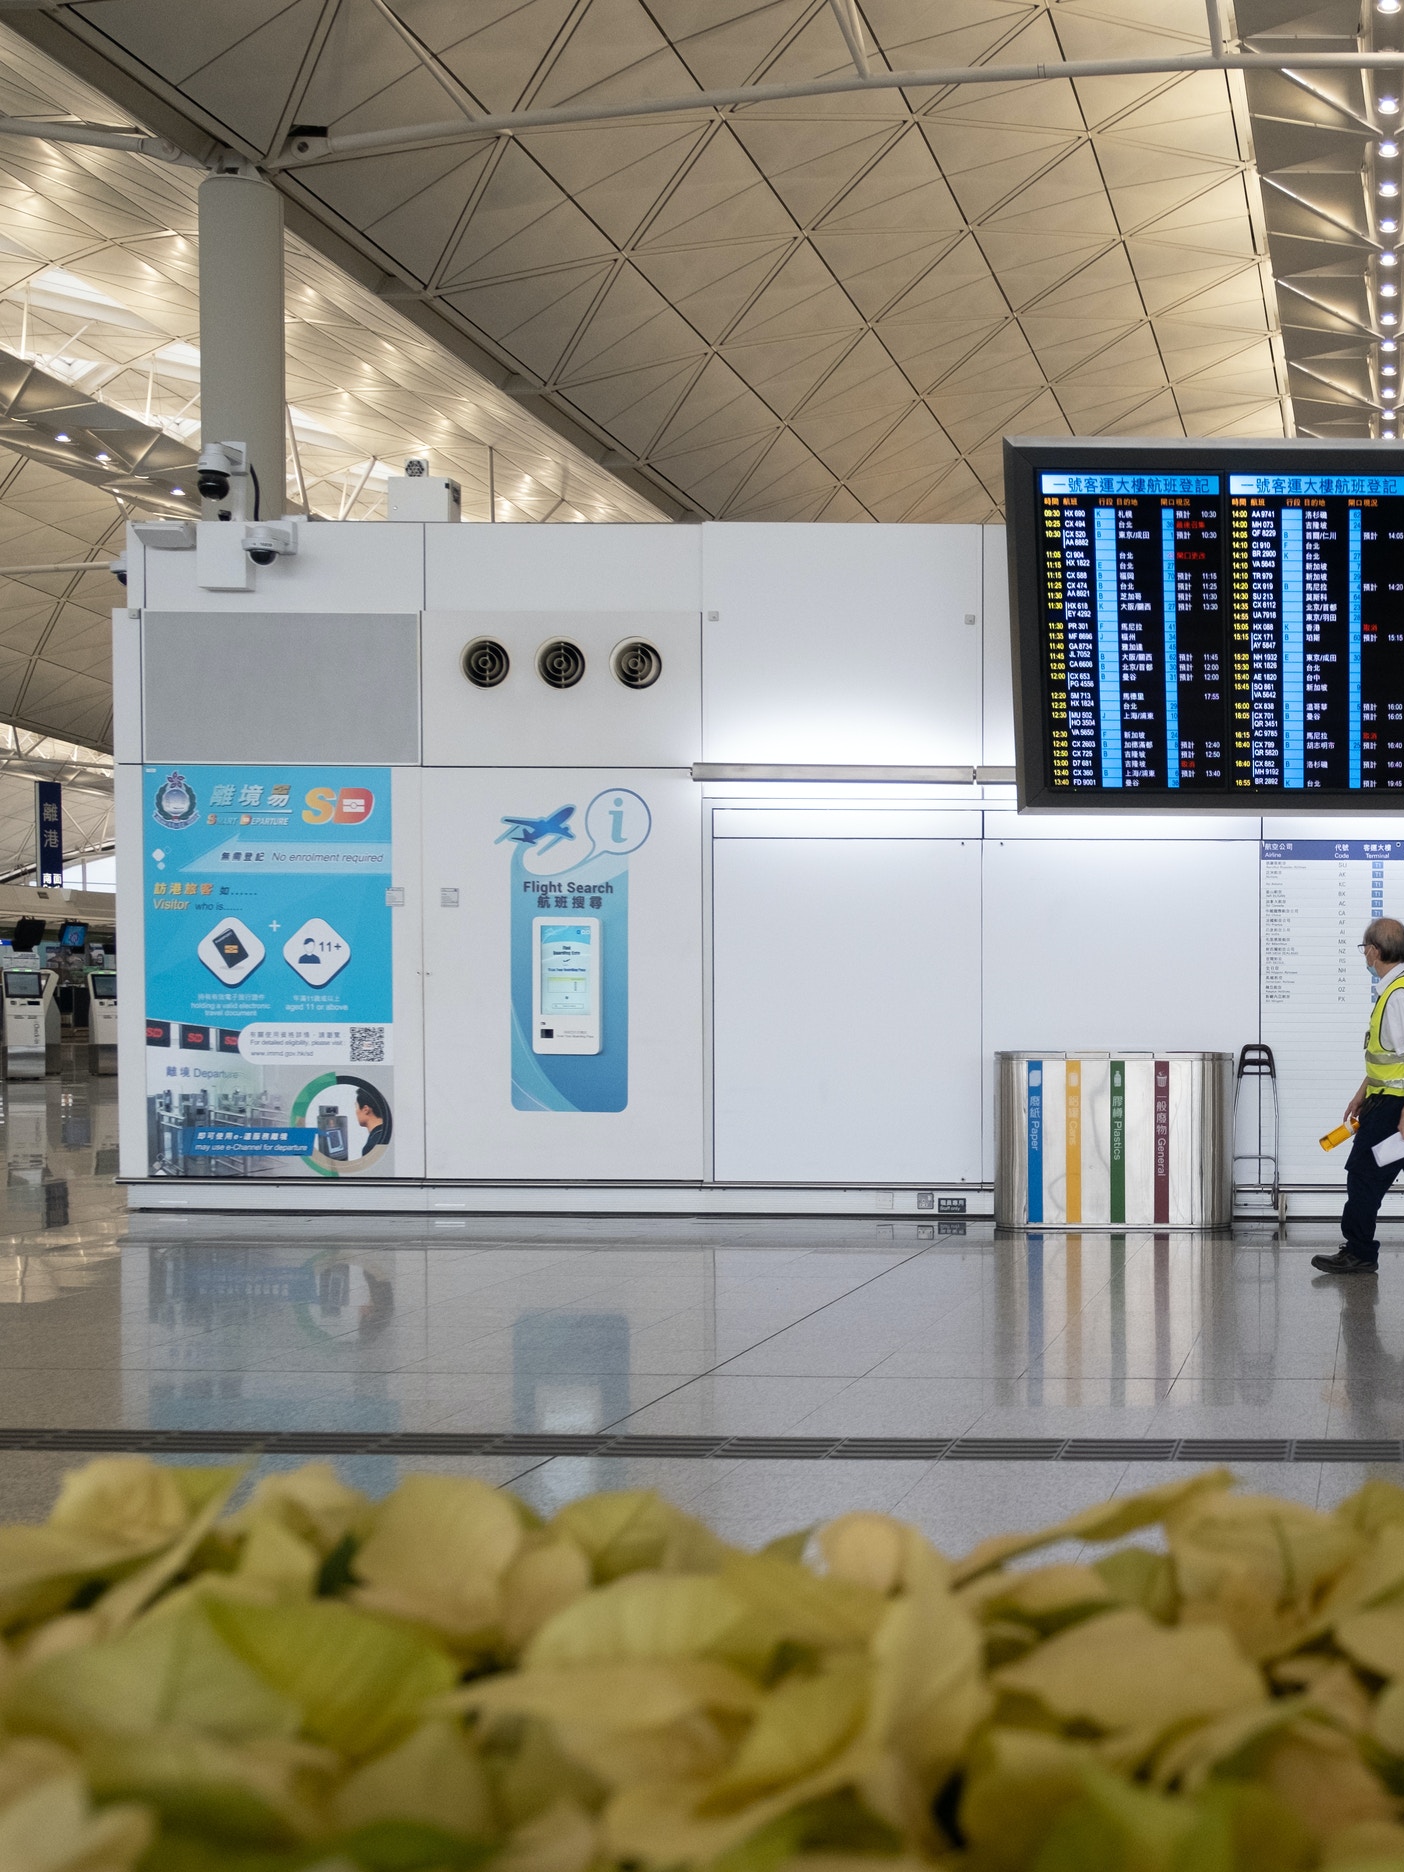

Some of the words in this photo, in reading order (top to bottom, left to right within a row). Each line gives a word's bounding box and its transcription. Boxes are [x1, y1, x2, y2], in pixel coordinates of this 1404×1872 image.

[1053, 478, 1209, 493] 一號客運大樓航班登記
[1241, 478, 1397, 493] 一號客運大樓航班登記
[1119, 521, 1133, 529] 台北
[302, 787, 375, 825] SD
[43, 802, 59, 848] 離港
[240, 814, 289, 826] DEPARTURE
[272, 853, 286, 861] No
[289, 853, 339, 862] enrolment
[342, 854, 383, 864] required
[523, 882, 562, 896] Flight
[567, 882, 613, 894] Search
[153, 899, 189, 910] Visitor
[195, 902, 213, 910] who
[537, 896, 602, 909] 航班搜尋
[319, 941, 342, 952] 11+
[191, 1002, 214, 1010] holding
[188, 1033, 203, 1042] SD
[193, 1068, 238, 1079] Departure
[1030, 1121, 1039, 1151] Paper
[1069, 1121, 1077, 1145] Cans
[1114, 1121, 1122, 1160] Plastics
[274, 1144, 307, 1152] departure
[1157, 1138, 1166, 1176] General
